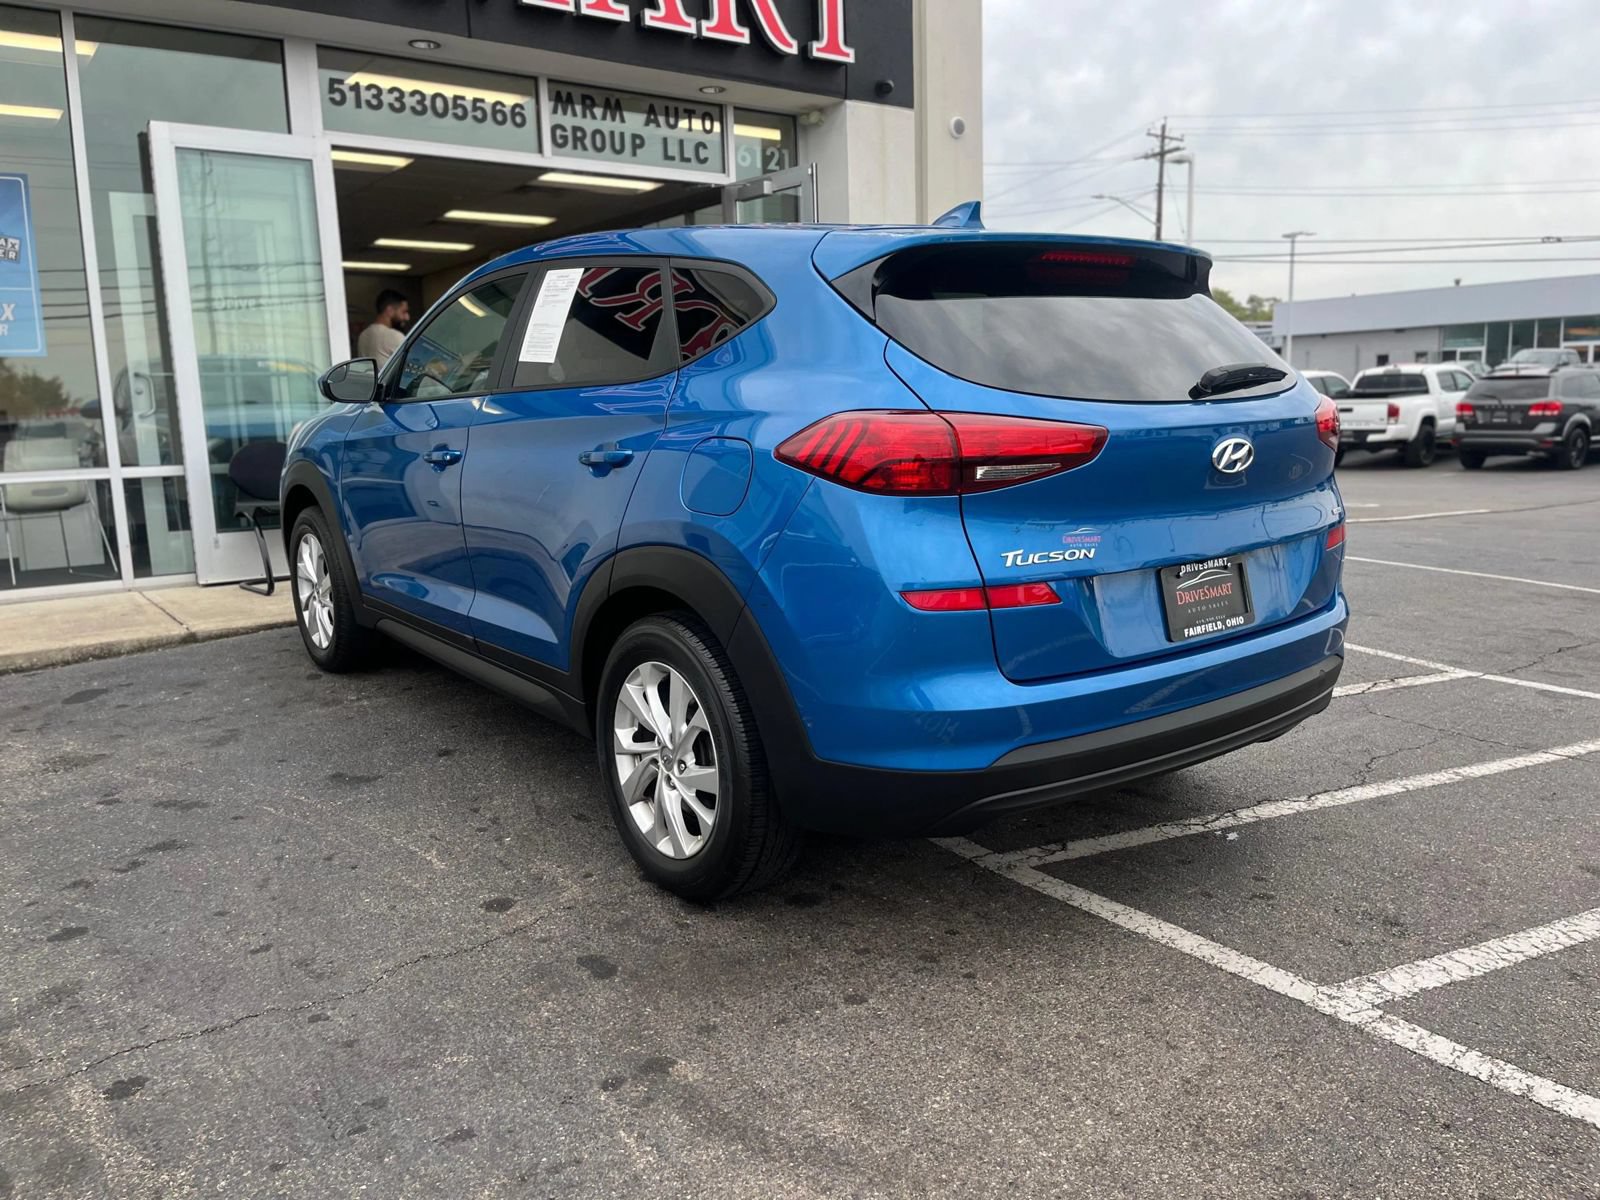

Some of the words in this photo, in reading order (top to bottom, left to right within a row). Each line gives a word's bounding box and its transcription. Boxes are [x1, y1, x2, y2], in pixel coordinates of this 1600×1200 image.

[328, 77, 527, 128] 5133305566
[552, 90, 626, 123] MRM
[644, 103, 714, 134] AUTO
[551, 123, 645, 157] GROUP
[662, 137, 709, 164] LLC
[737, 145, 790, 171] 6121
[1001, 547, 1096, 567] TUCSON
[1180, 557, 1229, 575] DRIVESMART
[1175, 582, 1233, 605] DRIVESMART
[1184, 621, 1226, 638] FAIRFIELD,
[1226, 615, 1245, 628] OHIO
